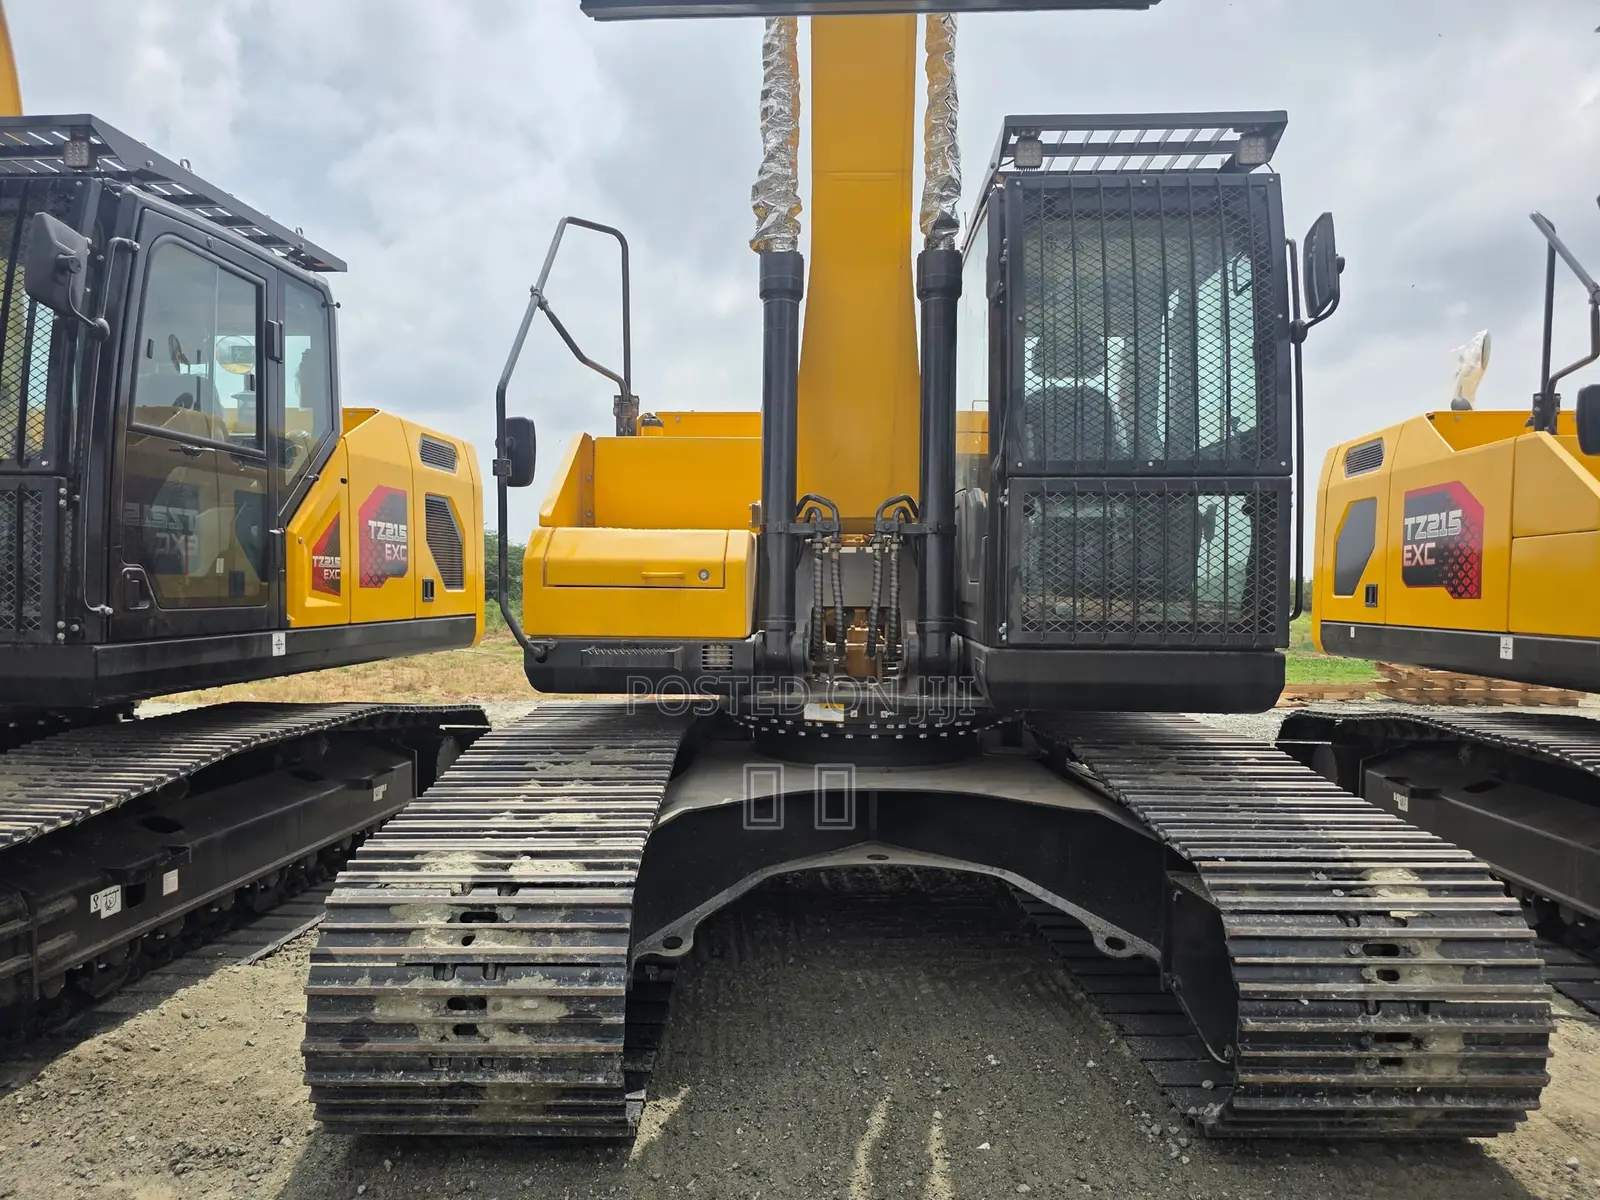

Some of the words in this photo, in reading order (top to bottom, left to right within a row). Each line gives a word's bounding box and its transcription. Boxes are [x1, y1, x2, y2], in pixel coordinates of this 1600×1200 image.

[368, 520, 407, 543] TZ215
[1404, 509, 1462, 541] TZ215
[312, 556, 340, 568] TZ215
[385, 544, 407, 561] EXC
[1403, 542, 1436, 567] EXC
[323, 569, 340, 579] EXC
